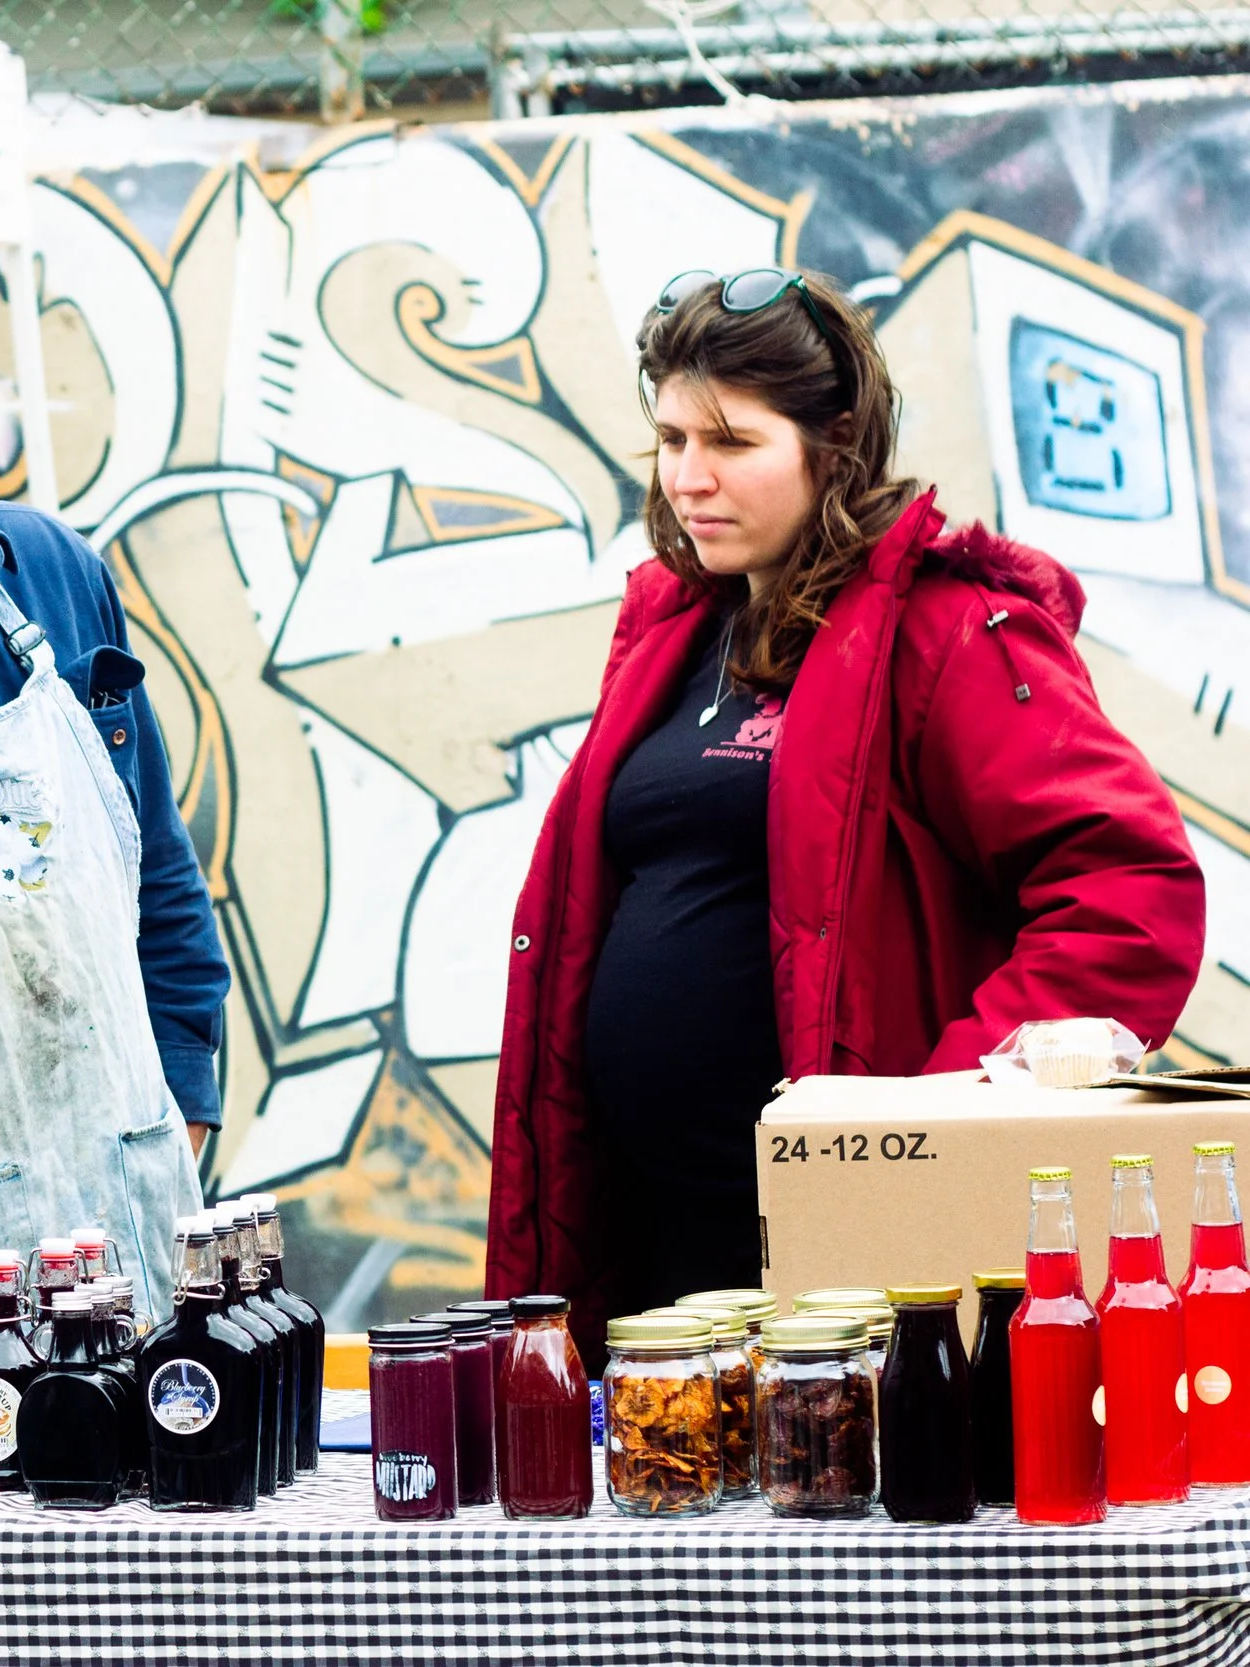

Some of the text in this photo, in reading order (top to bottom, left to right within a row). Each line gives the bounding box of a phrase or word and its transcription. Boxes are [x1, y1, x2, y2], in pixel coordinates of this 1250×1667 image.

[771, 1135, 809, 1162] 24
[880, 1132, 937, 1160] OZ.
[160, 1379, 206, 1397] Blueberry
[376, 1461, 436, 1502] MUSTARD
